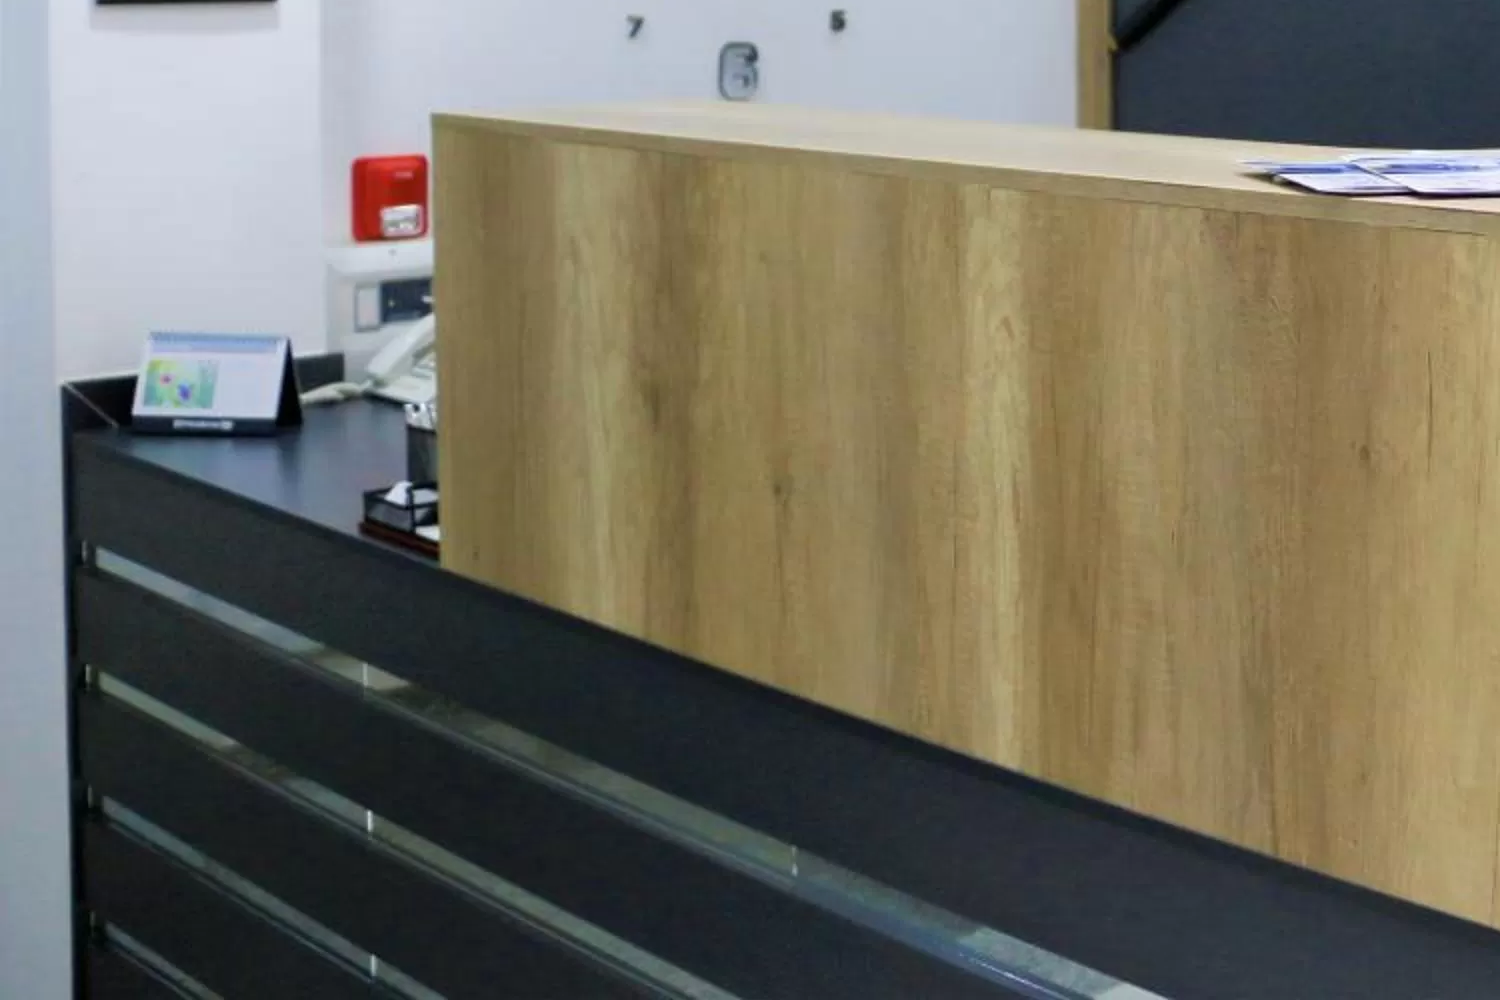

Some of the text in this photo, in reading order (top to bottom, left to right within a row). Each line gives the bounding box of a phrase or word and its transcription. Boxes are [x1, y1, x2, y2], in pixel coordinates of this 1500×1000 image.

[627, 16, 644, 38] 7
[830, 10, 847, 32] 5
[718, 42, 758, 100] 6
